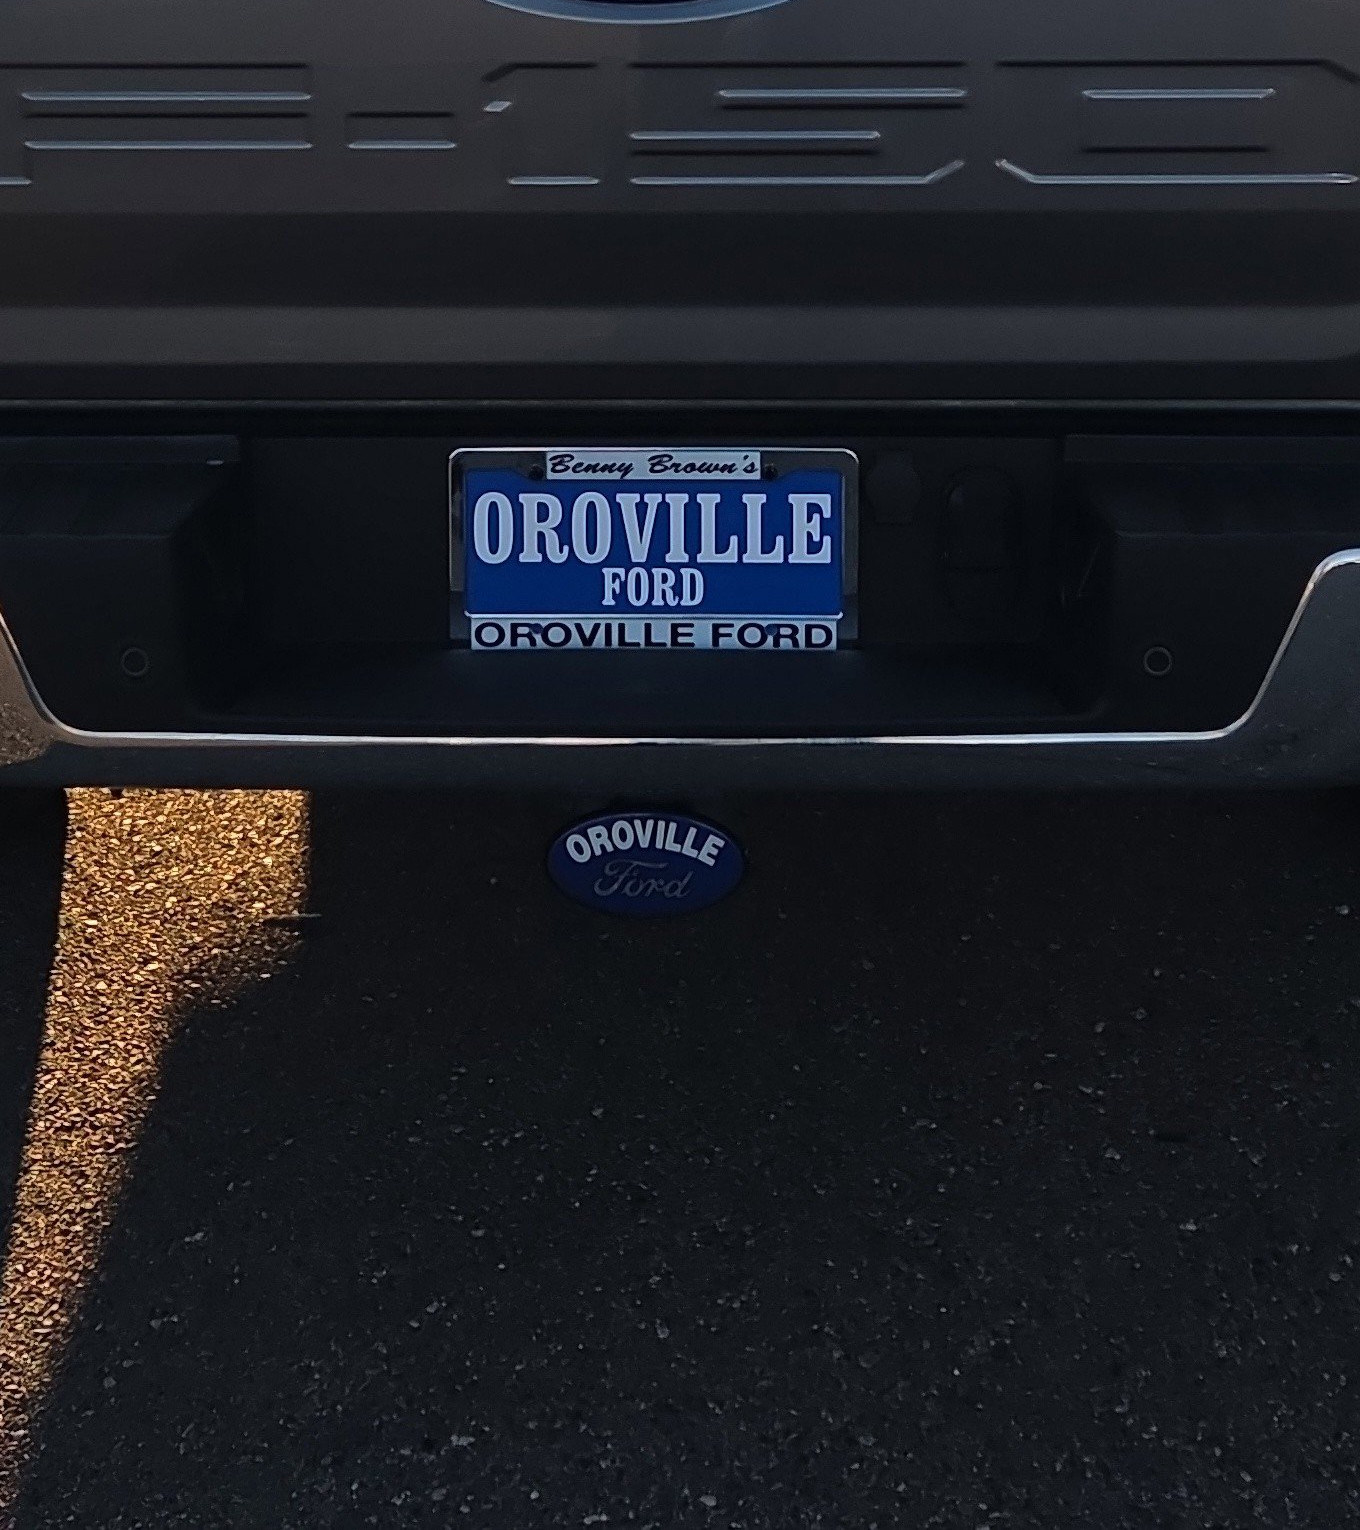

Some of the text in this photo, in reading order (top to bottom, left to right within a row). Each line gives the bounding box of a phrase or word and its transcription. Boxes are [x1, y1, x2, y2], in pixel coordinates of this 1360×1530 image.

[549, 453, 760, 479] Benny Brown's
[472, 491, 833, 565] OROVILLE
[601, 567, 705, 607] FORD
[474, 622, 834, 649] OROVILLE FORD
[565, 819, 726, 867] OROVILLE
[593, 858, 694, 899] Ford
